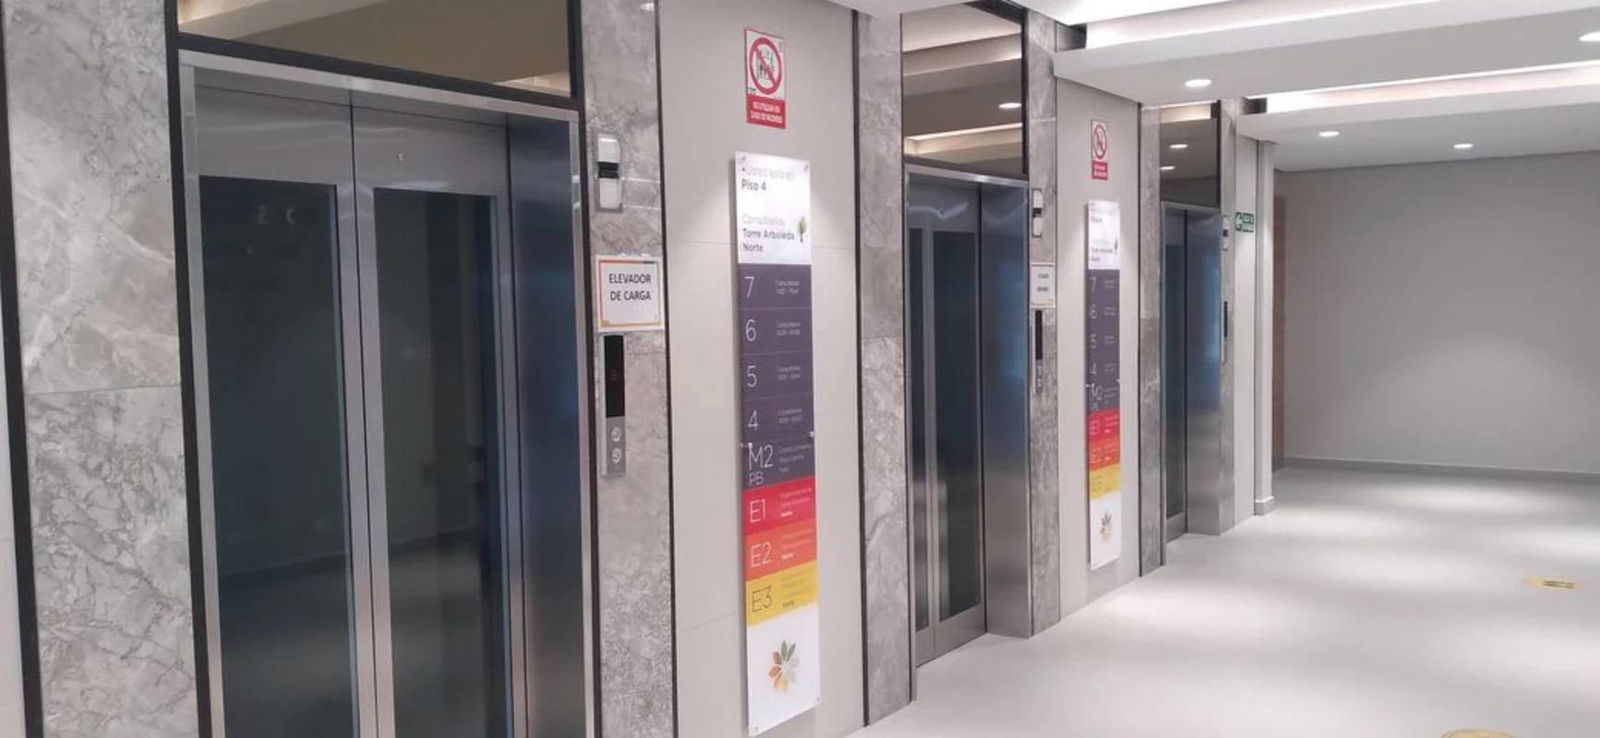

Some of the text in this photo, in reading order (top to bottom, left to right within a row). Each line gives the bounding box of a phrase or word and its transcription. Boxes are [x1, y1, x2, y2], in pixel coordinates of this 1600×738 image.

[741, 179, 767, 191] Piso 4
[743, 227, 796, 241] Torre Arboleda
[743, 243, 764, 253] Norte
[609, 273, 652, 284] ELEVADOR
[744, 276, 755, 298] 7
[610, 290, 652, 301] DE CARGA
[745, 319, 756, 342] 6
[746, 365, 757, 387] 5
[748, 409, 759, 431] 4
[747, 442, 773, 470] M2
[749, 471, 763, 487] PB
[750, 499, 766, 523] E1
[751, 541, 772, 568] E2
[752, 585, 773, 612] E3
